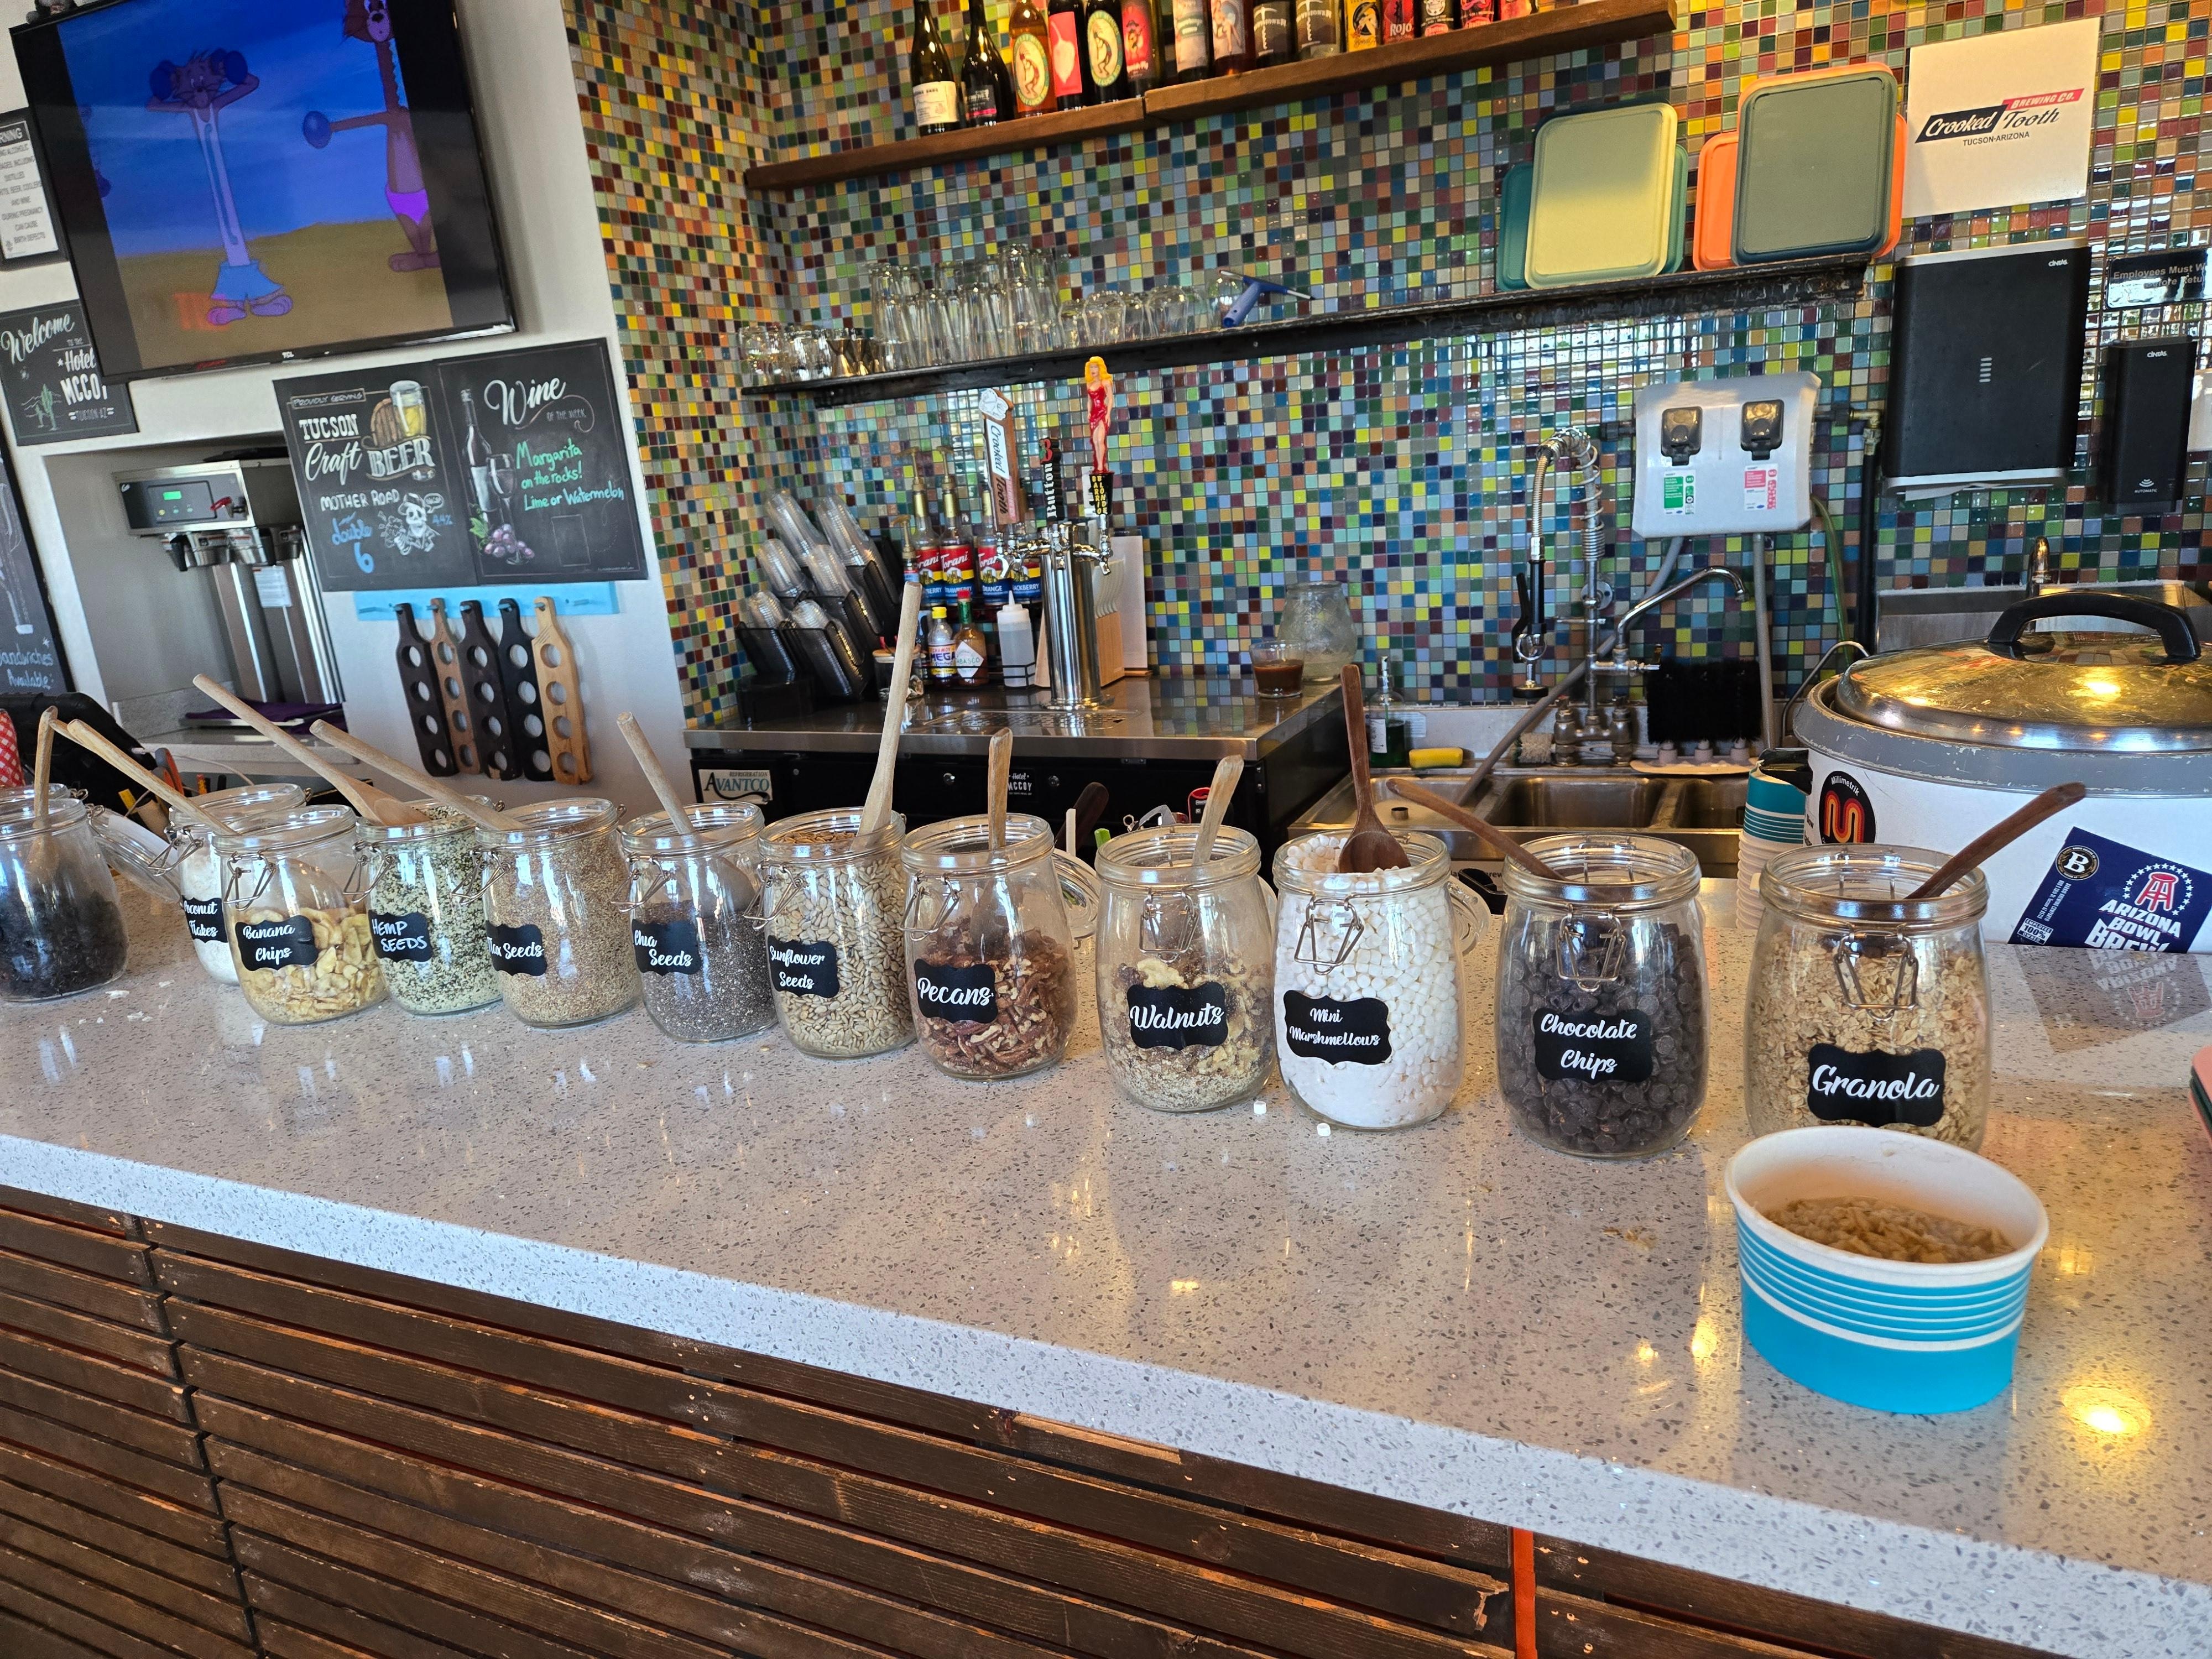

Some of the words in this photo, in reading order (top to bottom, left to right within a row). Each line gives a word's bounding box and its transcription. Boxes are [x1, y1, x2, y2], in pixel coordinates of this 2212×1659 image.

[1390, 23, 1412, 36] ROJO
[2011, 96, 2055, 109] BREWING
[1925, 111, 1997, 137] Crooked
[2002, 107, 2059, 129] Tooth
[0, 127, 23, 143] RNING
[2113, 268, 2166, 280] Employees
[2169, 264, 2193, 274] Must
[1, 314, 75, 365] Welcome
[65, 347, 97, 373] Hotel
[484, 378, 566, 425] Wine
[299, 414, 359, 440] TUCSON
[517, 437, 582, 471] Margarita
[990, 425, 1005, 473] Crooked
[305, 441, 363, 485] Craft
[367, 437, 436, 477] BEER
[521, 478, 534, 489] on
[533, 470, 549, 488] the
[1044, 463, 1057, 518] Button
[321, 493, 369, 512] MOTHER
[371, 489, 400, 506] ROAD
[523, 494, 549, 510] Lime
[549, 491, 562, 506] or
[564, 481, 624, 505] Watermelon
[996, 477, 1009, 514] Tooth
[1092, 476, 1102, 514] BARRIO
[1097, 476, 1108, 514] BLONDE
[941, 551, 968, 572] Torani
[703, 772, 770, 794] AVANTCO
[1008, 781, 1032, 791] MCCOY
[1831, 775, 1860, 796] Millimetrik
[2064, 852, 2089, 873] B
[2026, 920, 2051, 933] EMPLOYEE
[2098, 899, 2181, 938] ARIZONA
[243, 925, 296, 940] Banana
[634, 930, 657, 947] Chia
[2022, 932, 2041, 942] OWNED
[2024, 925, 2046, 939] 100%
[2107, 916, 2164, 946] BOWL
[380, 936, 427, 952] SEEDS
[503, 941, 545, 959] Seeds
[255, 946, 293, 965] Chips
[649, 948, 693, 967] Seeds
[769, 945, 825, 967] Sunflower
[779, 971, 815, 989] Seeds
[917, 977, 993, 1006] Pecans
[1129, 1002, 1225, 1030] Walnuts
[1310, 1008, 1343, 1024] Mini
[1541, 1013, 1637, 1040] Chocolate
[1289, 1025, 1381, 1046] Marshmellows
[1560, 1049, 1618, 1079] Chips
[1812, 1064, 1940, 1100] Granola
